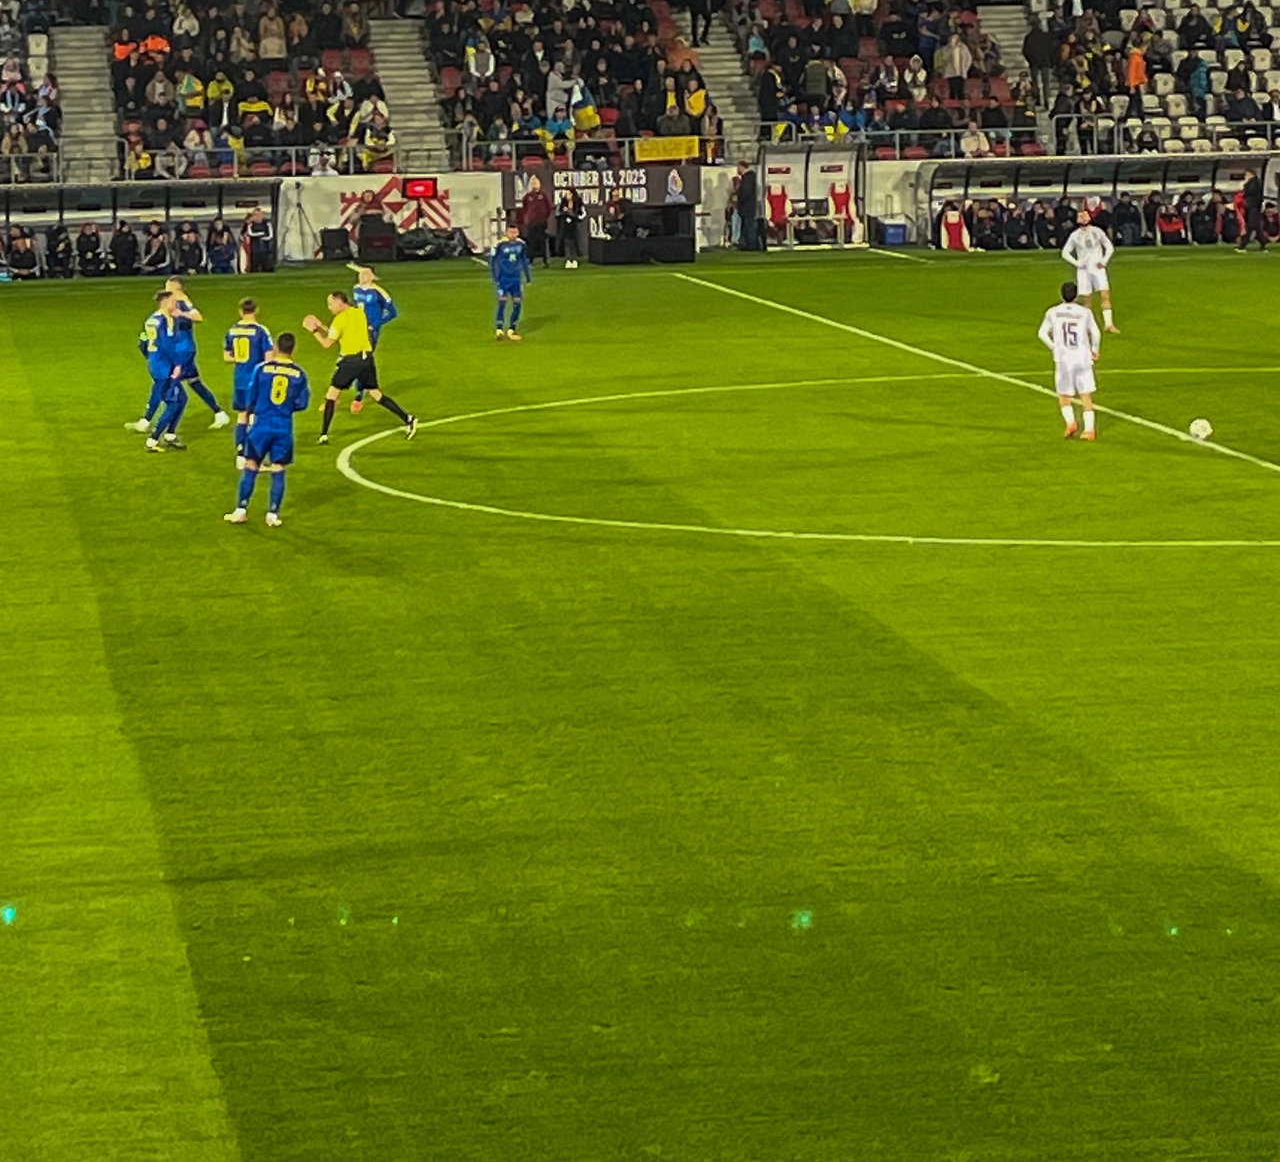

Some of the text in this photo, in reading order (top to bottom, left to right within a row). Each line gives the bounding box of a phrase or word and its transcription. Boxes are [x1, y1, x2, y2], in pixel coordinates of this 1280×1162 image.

[553, 170, 599, 188] OCTOBER
[619, 169, 647, 186] 2025
[1062, 321, 1078, 349] 15
